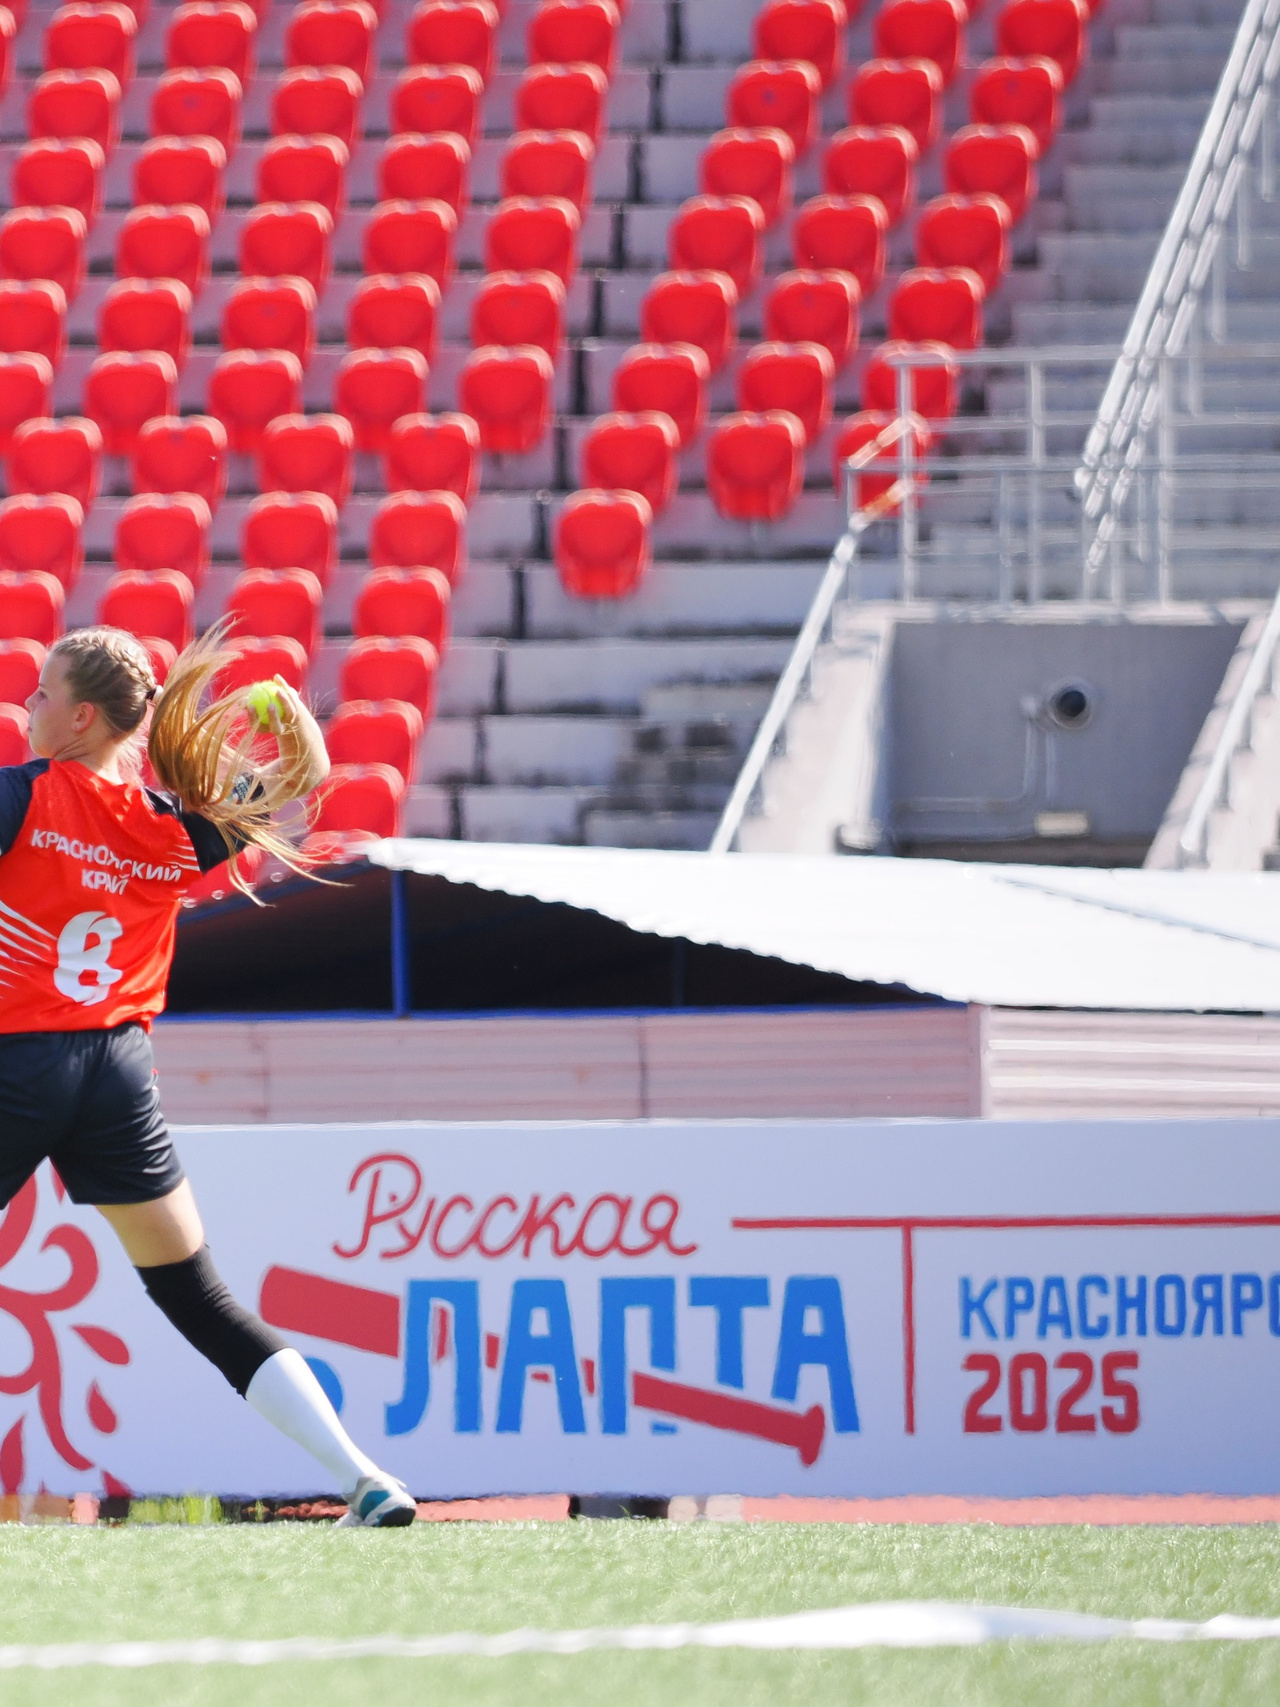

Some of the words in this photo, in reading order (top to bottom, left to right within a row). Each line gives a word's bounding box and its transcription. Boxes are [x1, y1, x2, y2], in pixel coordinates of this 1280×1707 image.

[332, 1153, 698, 1259] Русская
[384, 1275, 862, 1436] ЛАПТА
[962, 1352, 1140, 1434] 2025
